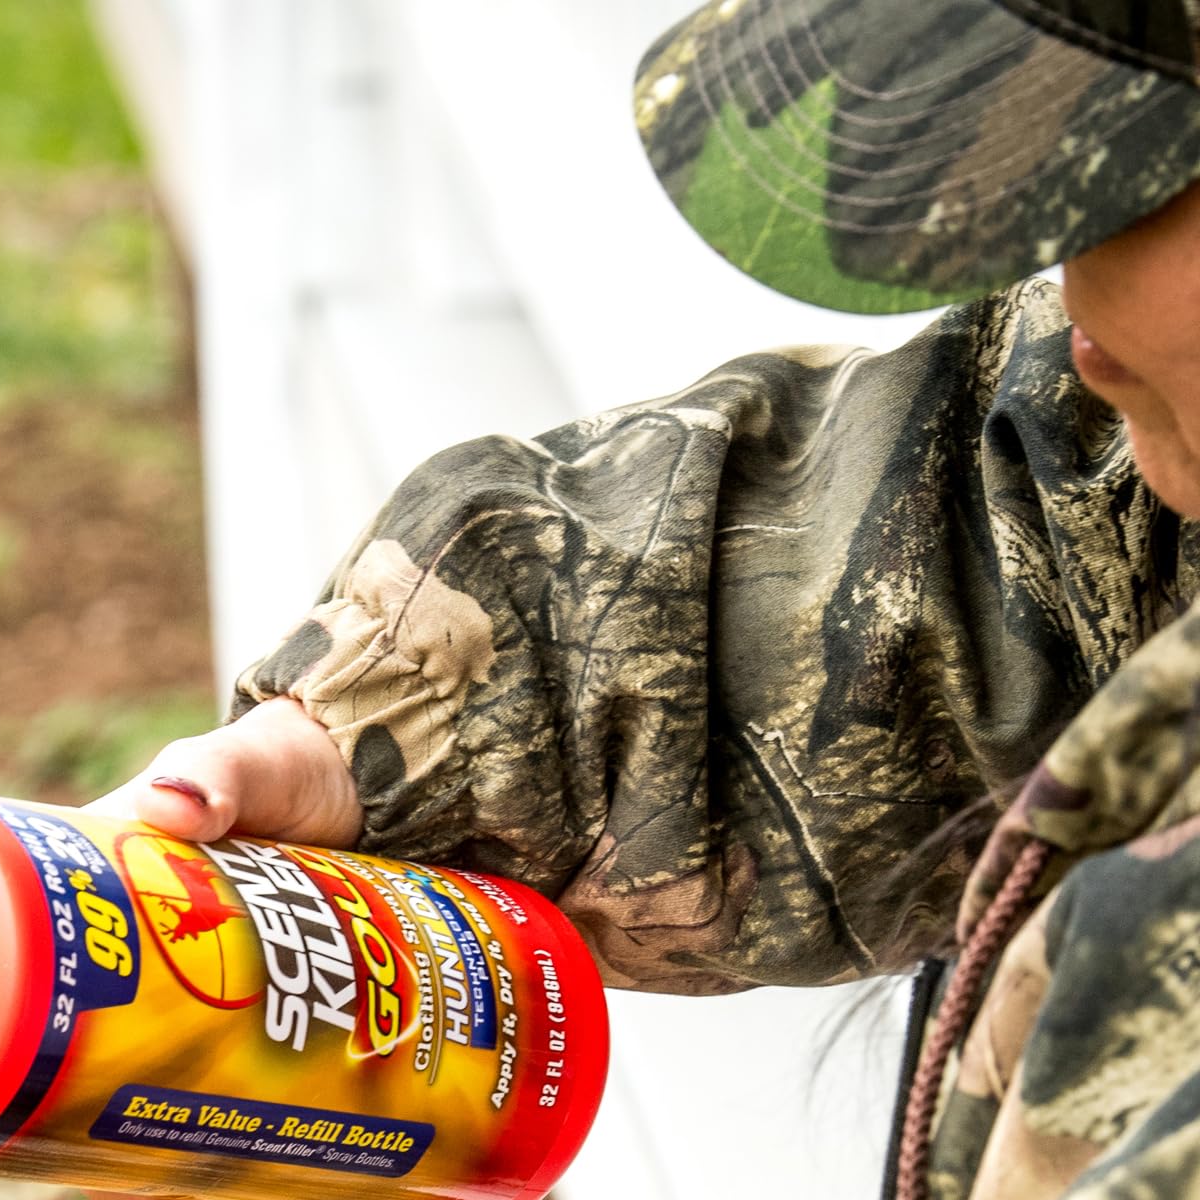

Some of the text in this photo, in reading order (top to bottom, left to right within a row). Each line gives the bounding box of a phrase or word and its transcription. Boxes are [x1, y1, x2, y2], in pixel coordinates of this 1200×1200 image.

[26, 816, 89, 867] 20
[373, 866, 441, 921] DRY
[373, 884, 420, 945] Spray
[441, 880, 465, 899] Go
[460, 901, 492, 934] and
[18, 831, 77, 1033] 32 FL OZ Refill
[64, 868, 134, 978] 99%
[198, 842, 310, 1052] SCENT
[229, 839, 357, 1032] KILLER
[283, 845, 400, 1057] GOLD
[414, 950, 434, 1071] Clothing
[423, 923, 469, 1045] HUNT
[496, 963, 514, 1006] Dry
[546, 1059, 562, 1078] FL
[548, 1030, 566, 1052] OZ
[491, 1042, 517, 1109] Apply
[539, 1084, 559, 1107] 32
[118, 1121, 146, 1140] Only
[148, 1127, 165, 1138] use
[166, 1129, 178, 1141] to
[179, 1130, 204, 1144] refill
[206, 1133, 250, 1150] Genuine
[250, 1138, 285, 1154] Scent
[322, 1148, 355, 1166] Spray
[122, 1096, 192, 1125] Extra
[196, 1105, 261, 1133] Value
[277, 1117, 340, 1144] Refill
[342, 1125, 415, 1153] Bottle
